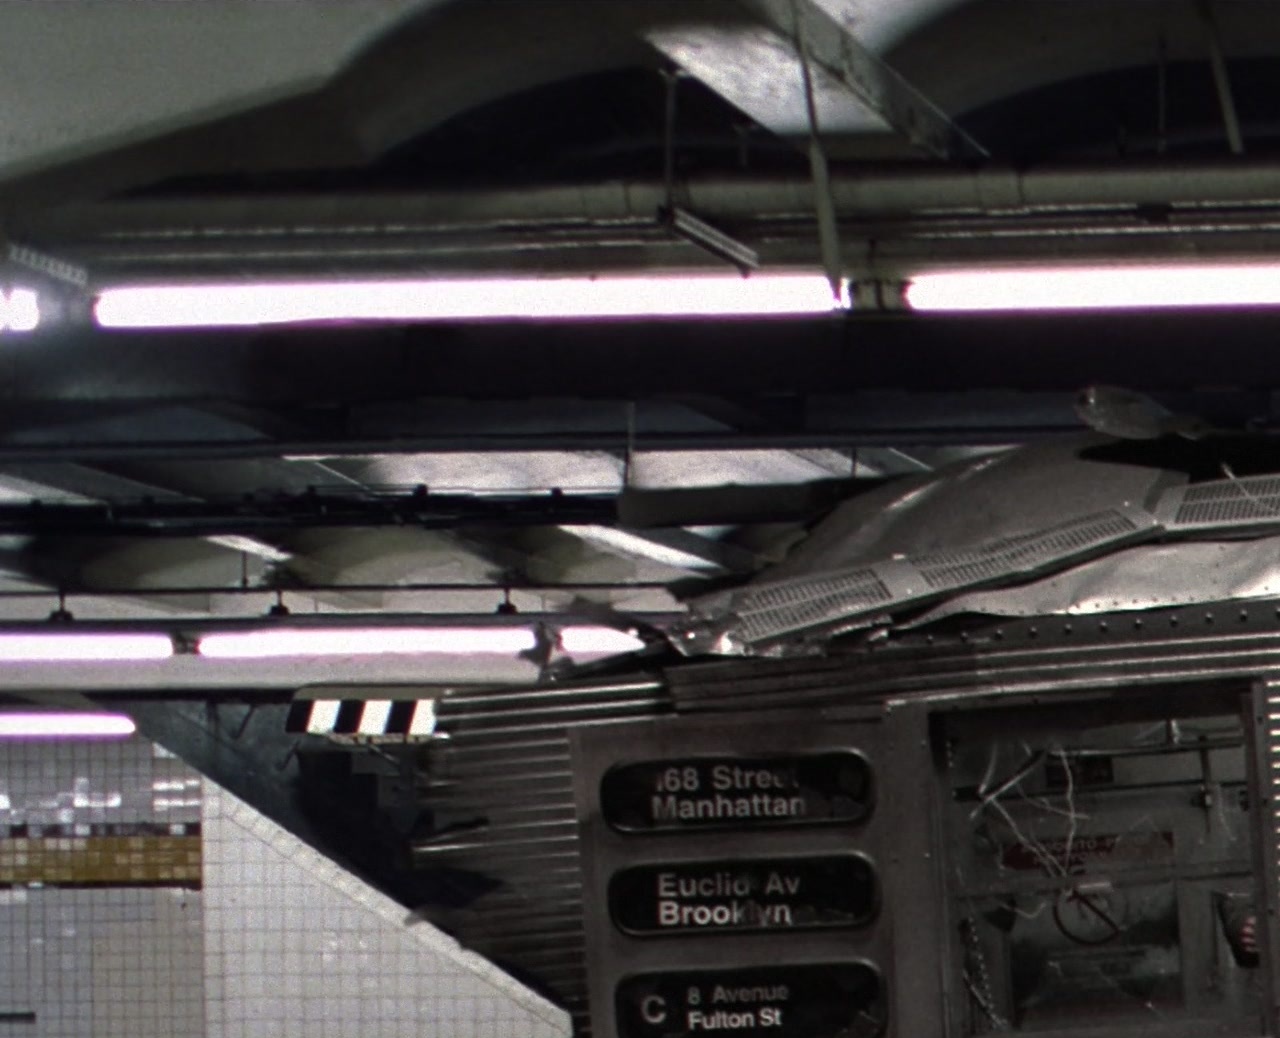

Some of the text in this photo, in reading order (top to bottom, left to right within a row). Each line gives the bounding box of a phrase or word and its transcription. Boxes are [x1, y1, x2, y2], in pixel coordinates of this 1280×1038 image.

[651, 794, 806, 820] Manhattan
[765, 872, 801, 896] Av
[659, 900, 792, 927] Brookyn
[712, 985, 790, 1004] Avenue
[642, 996, 666, 1024] C
[686, 1008, 782, 1031] Fulton St
